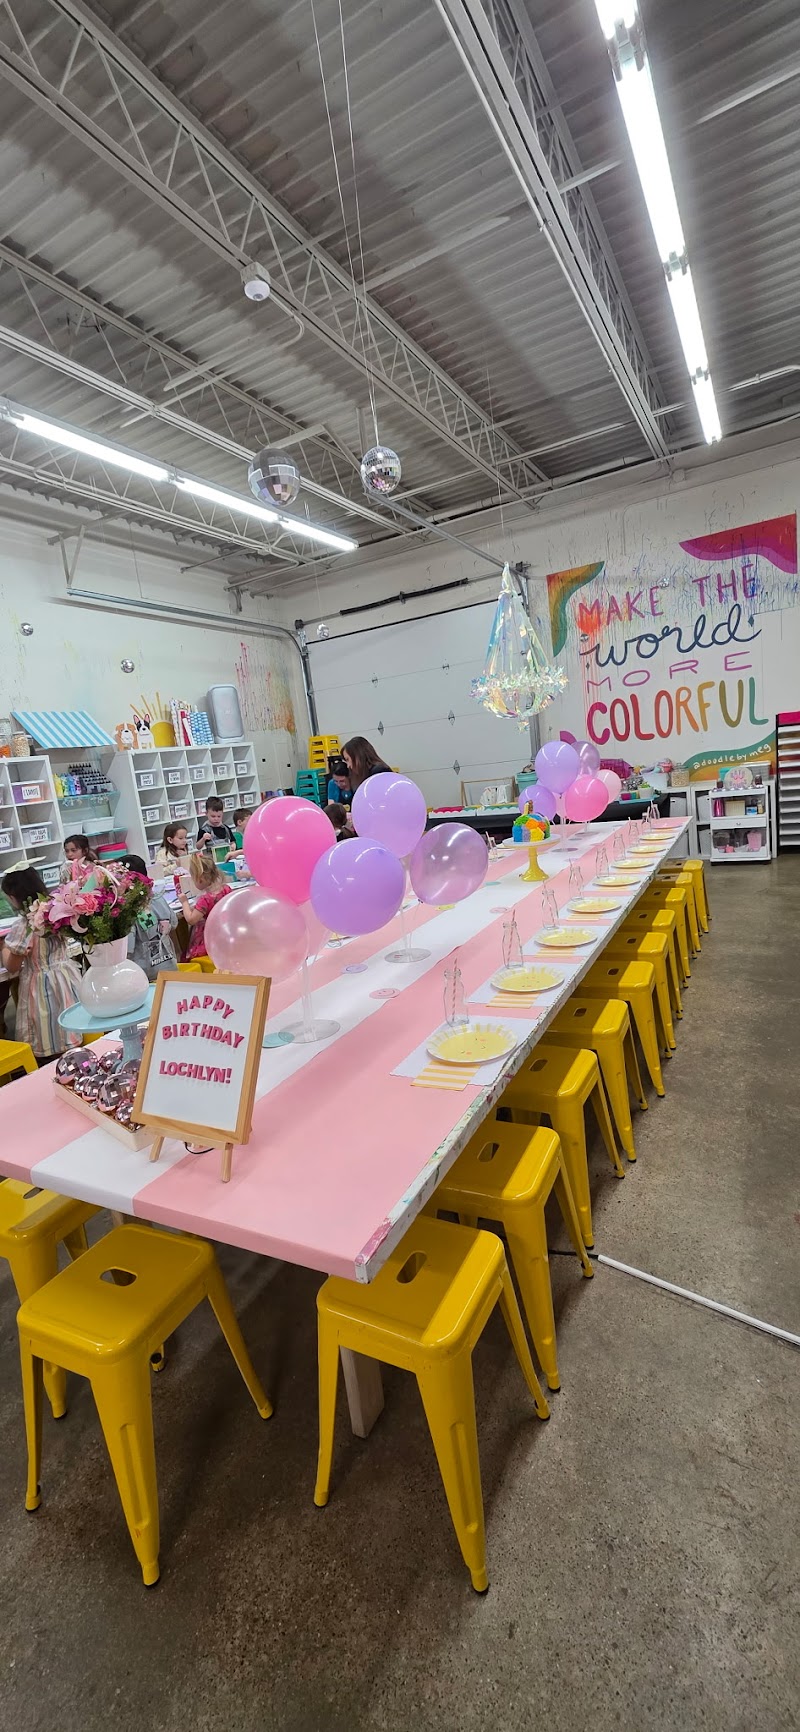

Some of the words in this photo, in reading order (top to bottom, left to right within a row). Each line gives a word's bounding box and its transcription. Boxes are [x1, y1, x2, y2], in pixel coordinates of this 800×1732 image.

[578, 586, 665, 628] MAKE
[692, 563, 759, 608] THE
[579, 603, 763, 667] world
[586, 651, 753, 694] MORE
[586, 676, 770, 746] COLORFUL
[176, 995, 234, 1020] HAPPY
[162, 1022, 245, 1049] BIRTHDAY
[159, 1060, 233, 1084] LOCHLYN!
